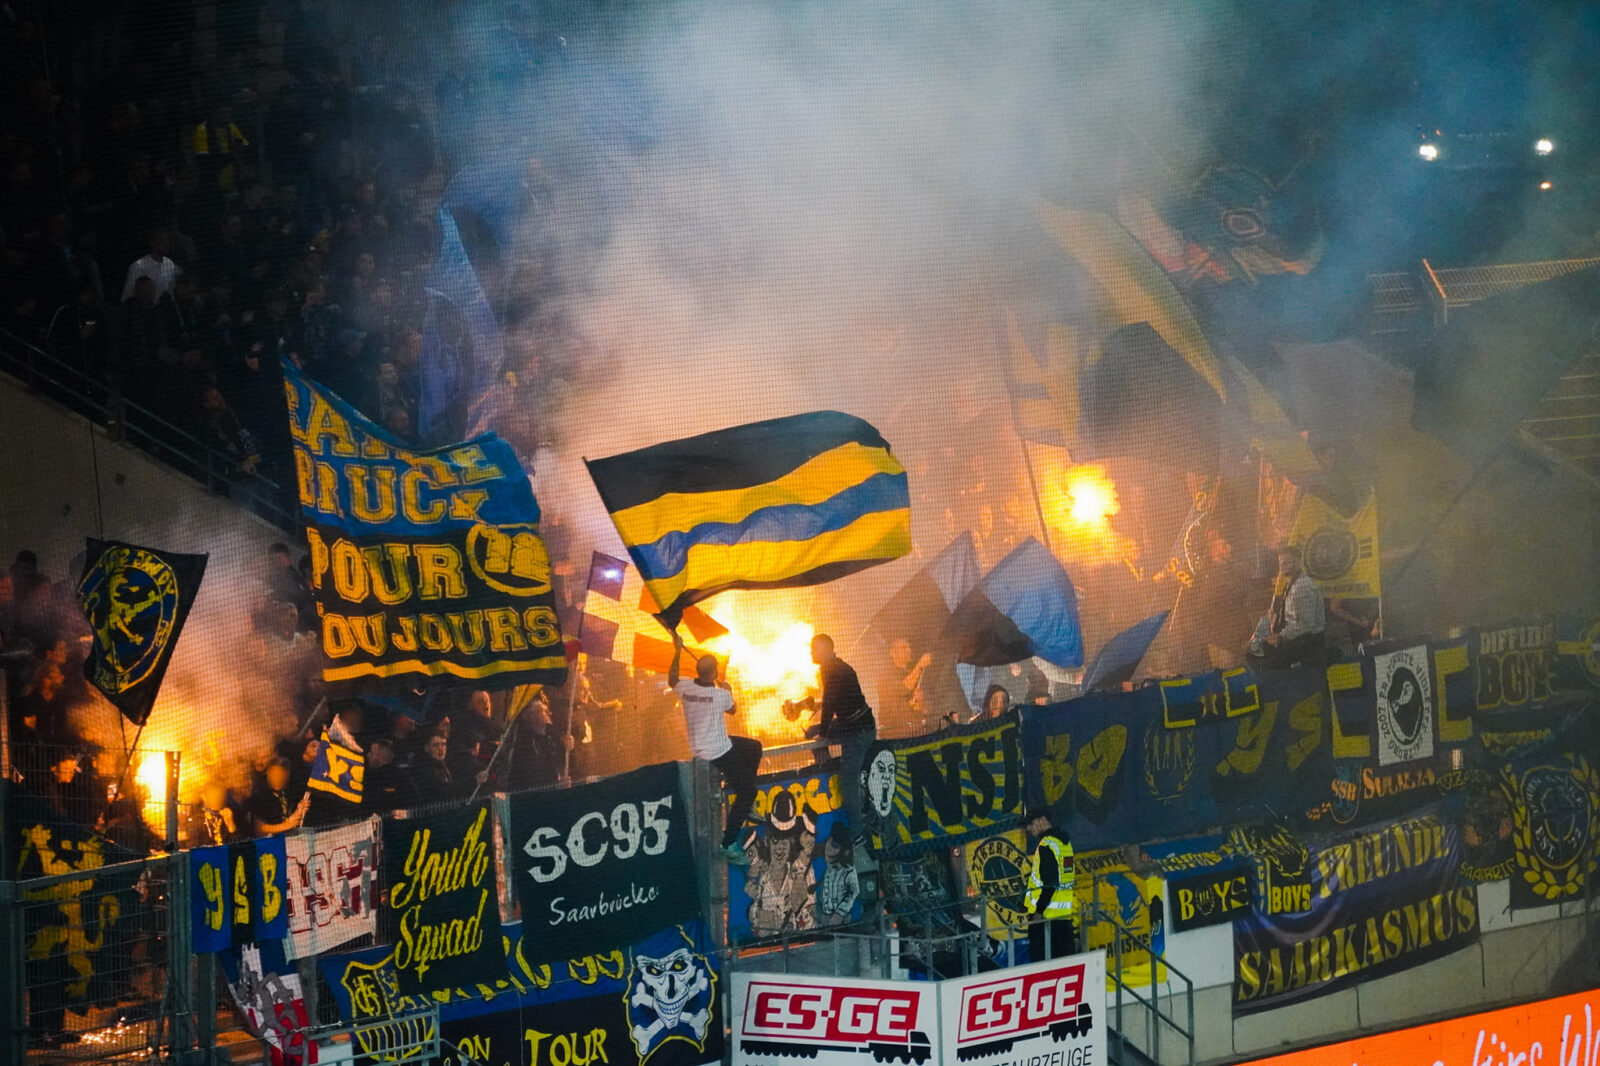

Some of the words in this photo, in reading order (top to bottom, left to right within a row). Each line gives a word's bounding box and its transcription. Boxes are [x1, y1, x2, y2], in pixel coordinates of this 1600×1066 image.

[306, 527, 467, 605] POUR
[317, 605, 561, 658] OUJOURS
[391, 807, 489, 909] Youth
[523, 795, 673, 883] SC95
[394, 888, 489, 983] Squad
[549, 882, 660, 925] Saarbrücke
[1271, 883, 1312, 913] BOYS
[1239, 886, 1476, 1000] SAARKASMUS
[525, 1028, 609, 1066] TOUR
